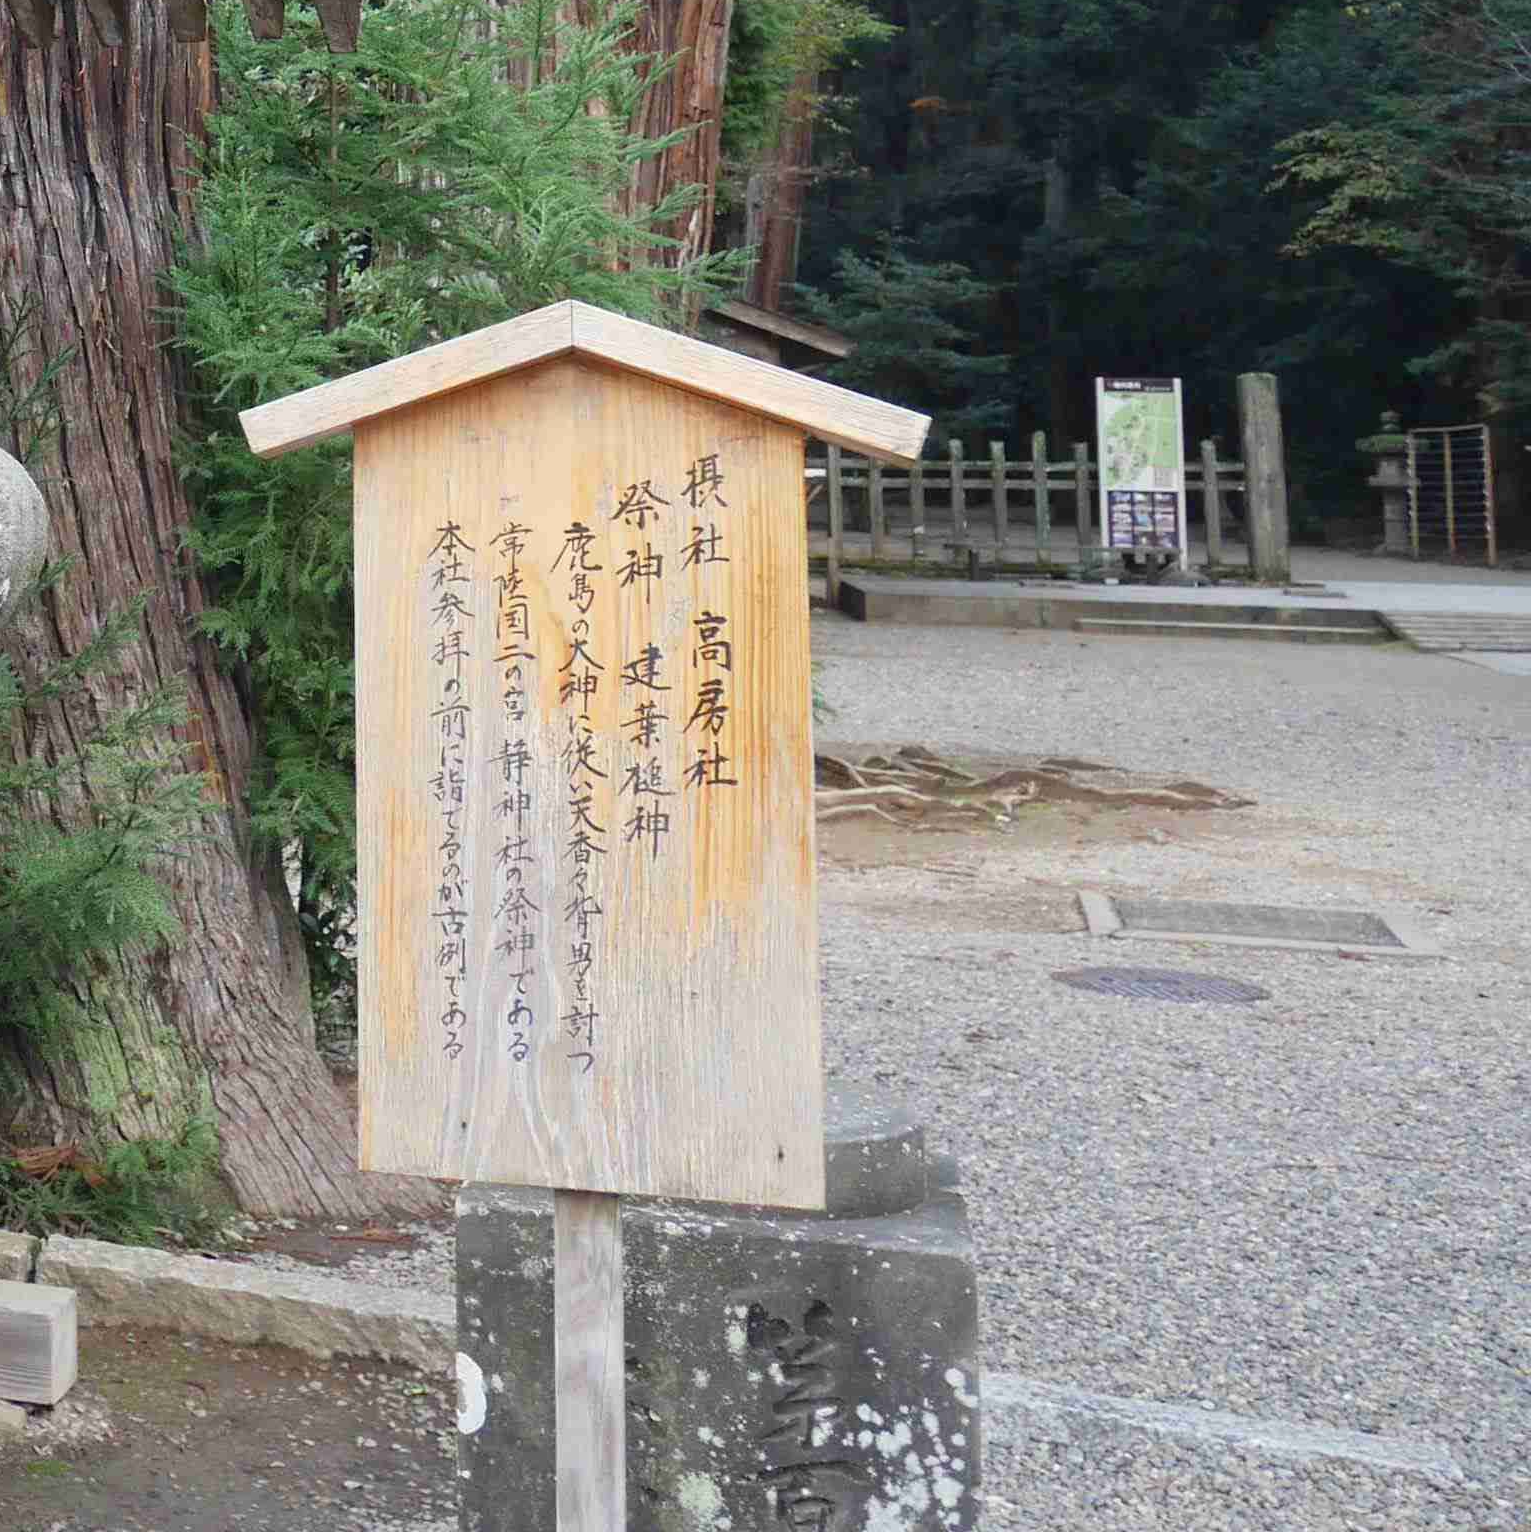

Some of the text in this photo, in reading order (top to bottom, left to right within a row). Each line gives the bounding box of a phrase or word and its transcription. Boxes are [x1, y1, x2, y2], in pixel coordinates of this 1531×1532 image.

[611, 479, 671, 605] 祭神
[683, 611, 738, 789] 高房社
